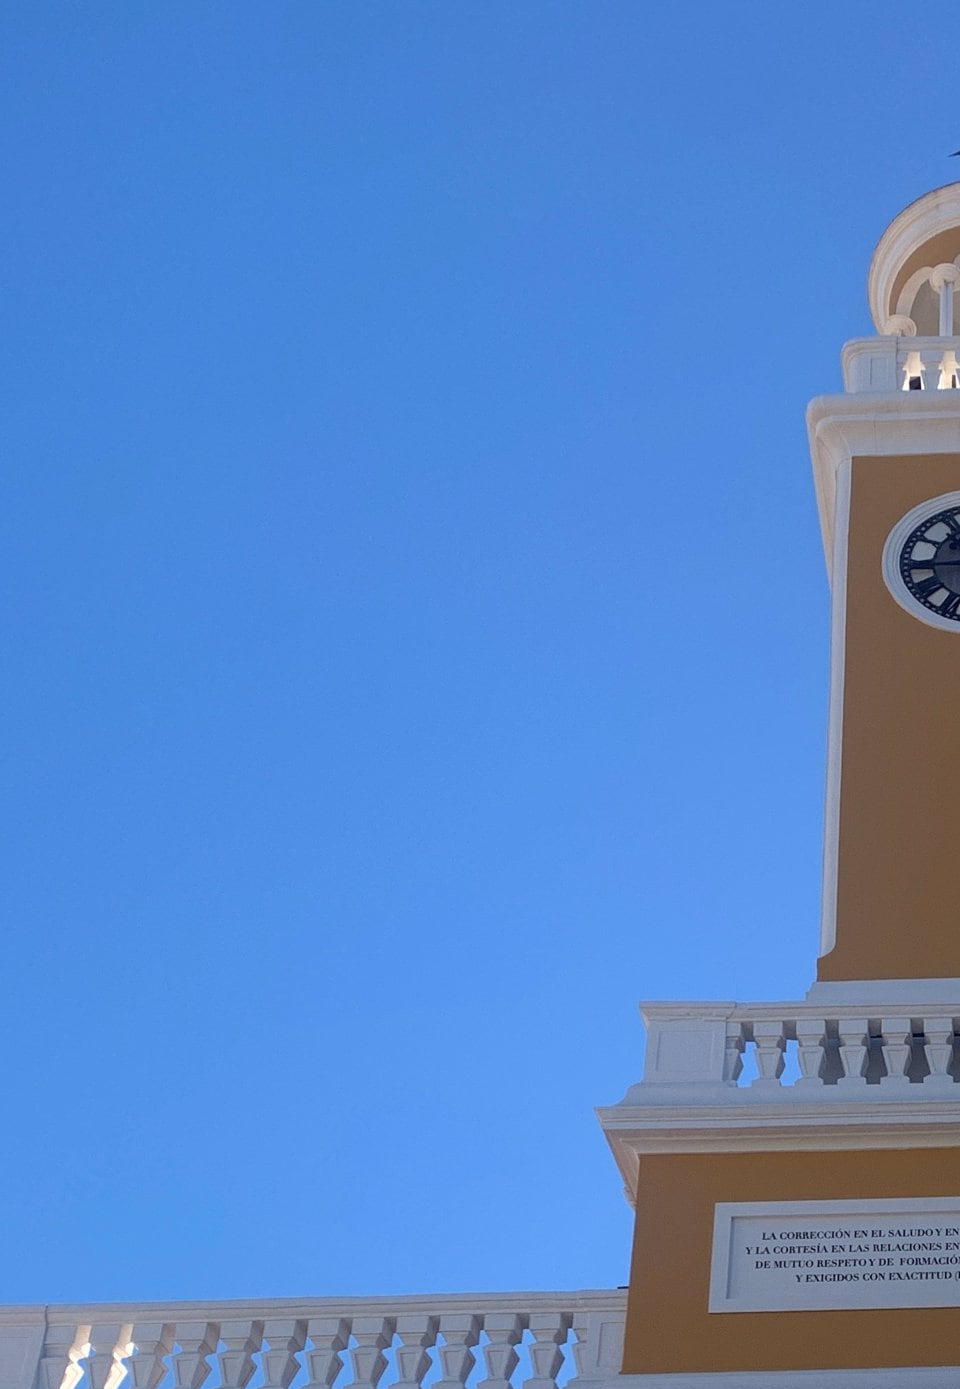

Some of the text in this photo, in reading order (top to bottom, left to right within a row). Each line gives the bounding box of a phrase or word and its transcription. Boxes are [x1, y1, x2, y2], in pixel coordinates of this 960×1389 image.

[762, 1232, 777, 1241] LA
[780, 1228, 851, 1240] CORRECCIÓN
[854, 1230, 868, 1238] EN
[871, 1229, 886, 1238] EL
[888, 1229, 934, 1238] SALUDO
[935, 1228, 943, 1237] Y
[945, 1228, 959, 1237] EN
[745, 1247, 753, 1255] Y
[755, 1246, 770, 1255] LA
[773, 1243, 828, 1255] CORTESÍA
[831, 1245, 846, 1254] EN
[849, 1244, 870, 1253] LAS
[873, 1242, 942, 1252] RELACIONES
[755, 1260, 771, 1269] DE
[773, 1260, 815, 1269] MUTUO
[816, 1258, 867, 1268] RESPETO
[869, 1258, 877, 1267] Y
[878, 1258, 894, 1267] DE
[795, 1274, 803, 1283] Y
[805, 1272, 860, 1283] EXIGIDOS
[862, 1272, 886, 1281] CON
[889, 1271, 952, 1281] EXACTITUD
